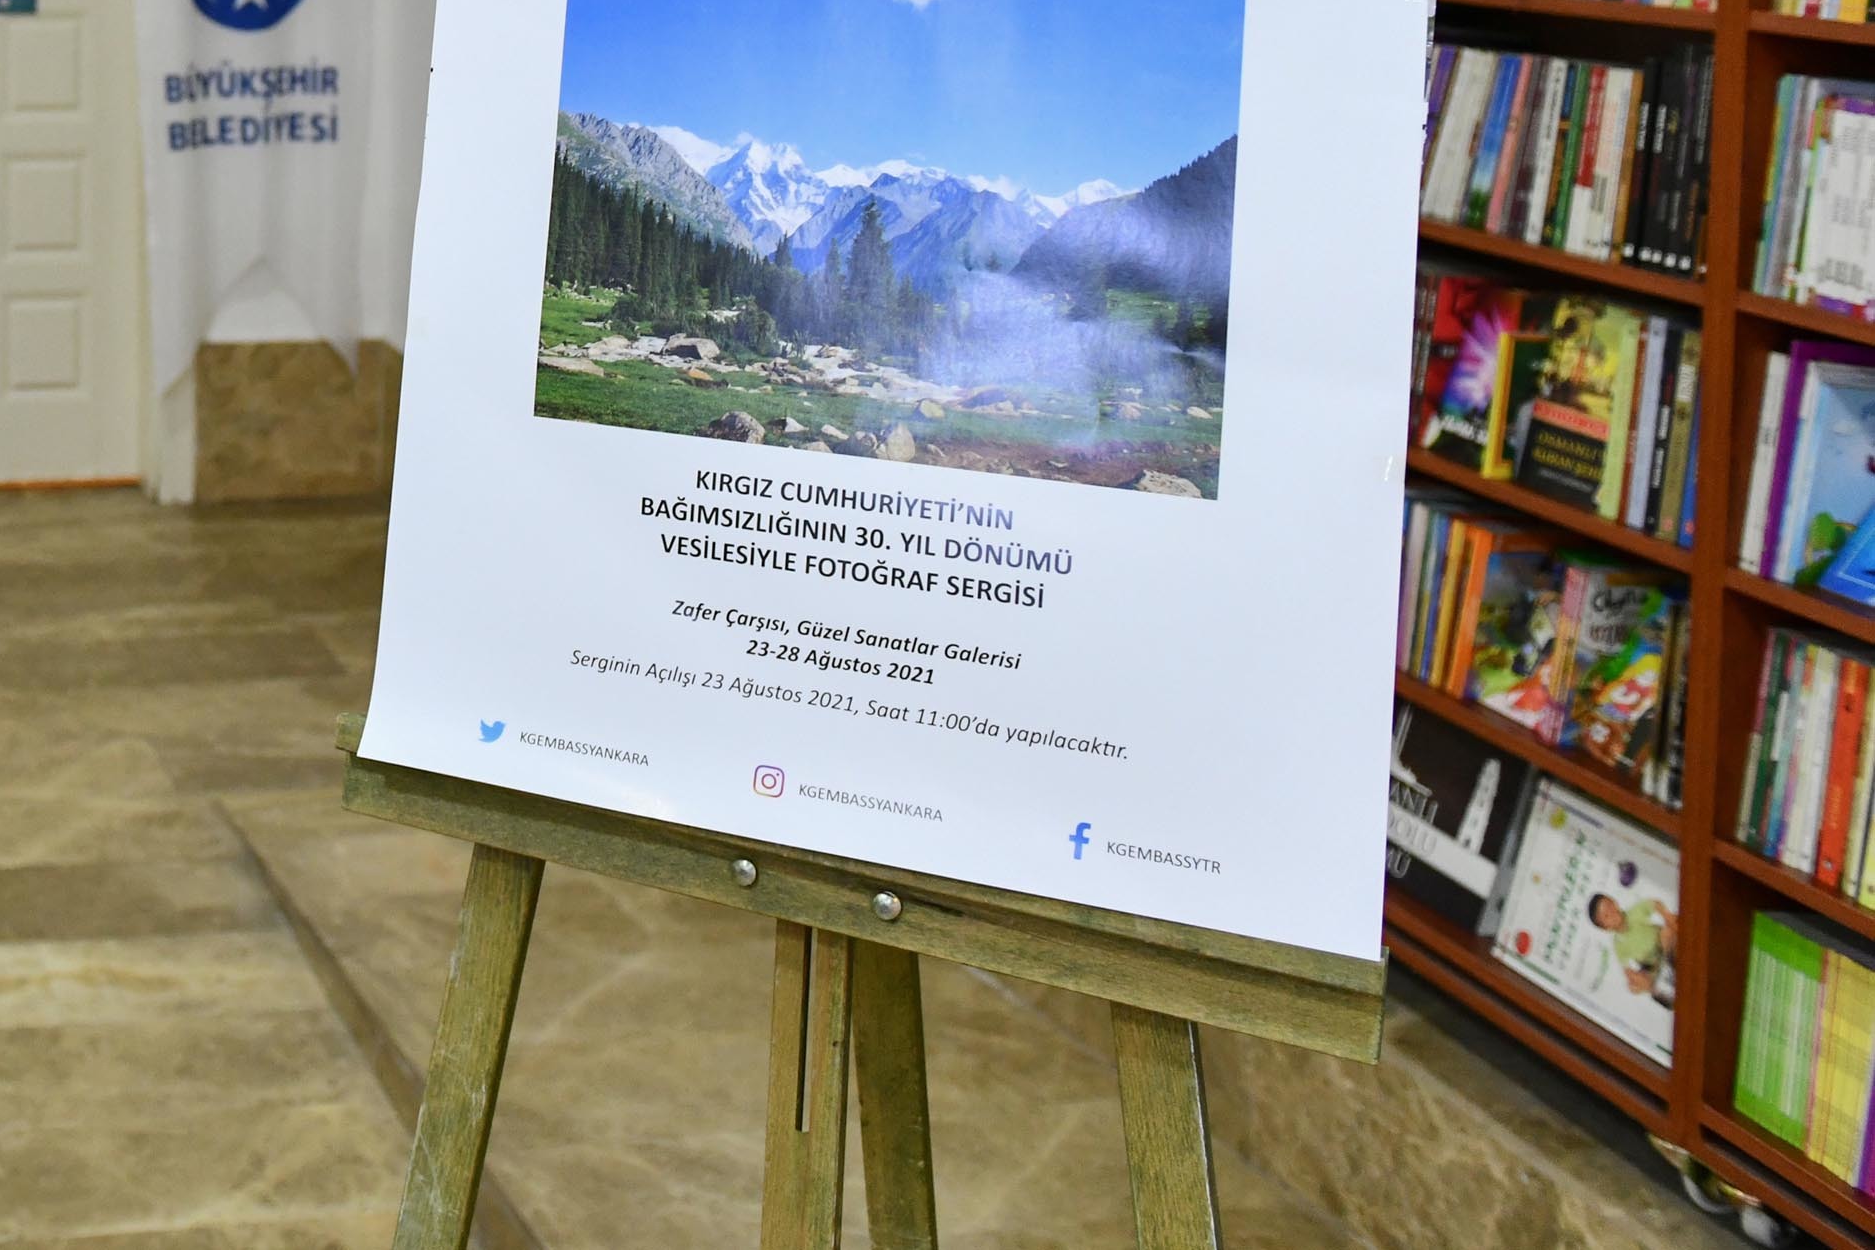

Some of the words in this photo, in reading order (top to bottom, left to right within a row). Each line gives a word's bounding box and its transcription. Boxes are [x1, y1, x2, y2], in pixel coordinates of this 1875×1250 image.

[696, 470, 774, 499] KIRGIZ
[781, 481, 1014, 531] CUMHURİYETİ’NİN
[641, 496, 847, 544] BAĞIMSIZLIĞININ
[855, 527, 891, 551] 30.
[901, 532, 937, 557] YIL
[945, 537, 1073, 575] DÖNÜMÜ
[661, 534, 798, 573] VESİLESİYLE
[805, 555, 940, 593] FOTOĞRAF
[946, 576, 1045, 609] SERGİSİ
[672, 600, 722, 623] Zafer
[725, 608, 790, 636] Çarşısı,
[797, 619, 850, 643] Güzel
[854, 629, 939, 657] Sanatlar
[944, 643, 1023, 670] Galerisi
[746, 640, 800, 663] 23-28
[804, 649, 882, 677] Ağustos
[886, 662, 935, 686] 2021
[570, 650, 641, 674] Serginin
[645, 662, 696, 686] Açılışı
[701, 672, 724, 690] 23
[728, 676, 803, 703] Ağustos
[807, 689, 859, 716] 2021,
[865, 699, 910, 723] Saat
[914, 707, 1001, 738] 11:00’da
[1006, 726, 1128, 760] yapılacaktır.
[519, 731, 649, 767] KGEMBASSYANKARA
[798, 784, 944, 823] KGEMBASSYANKARA
[1106, 841, 1221, 876] KGEMBASSYTR
